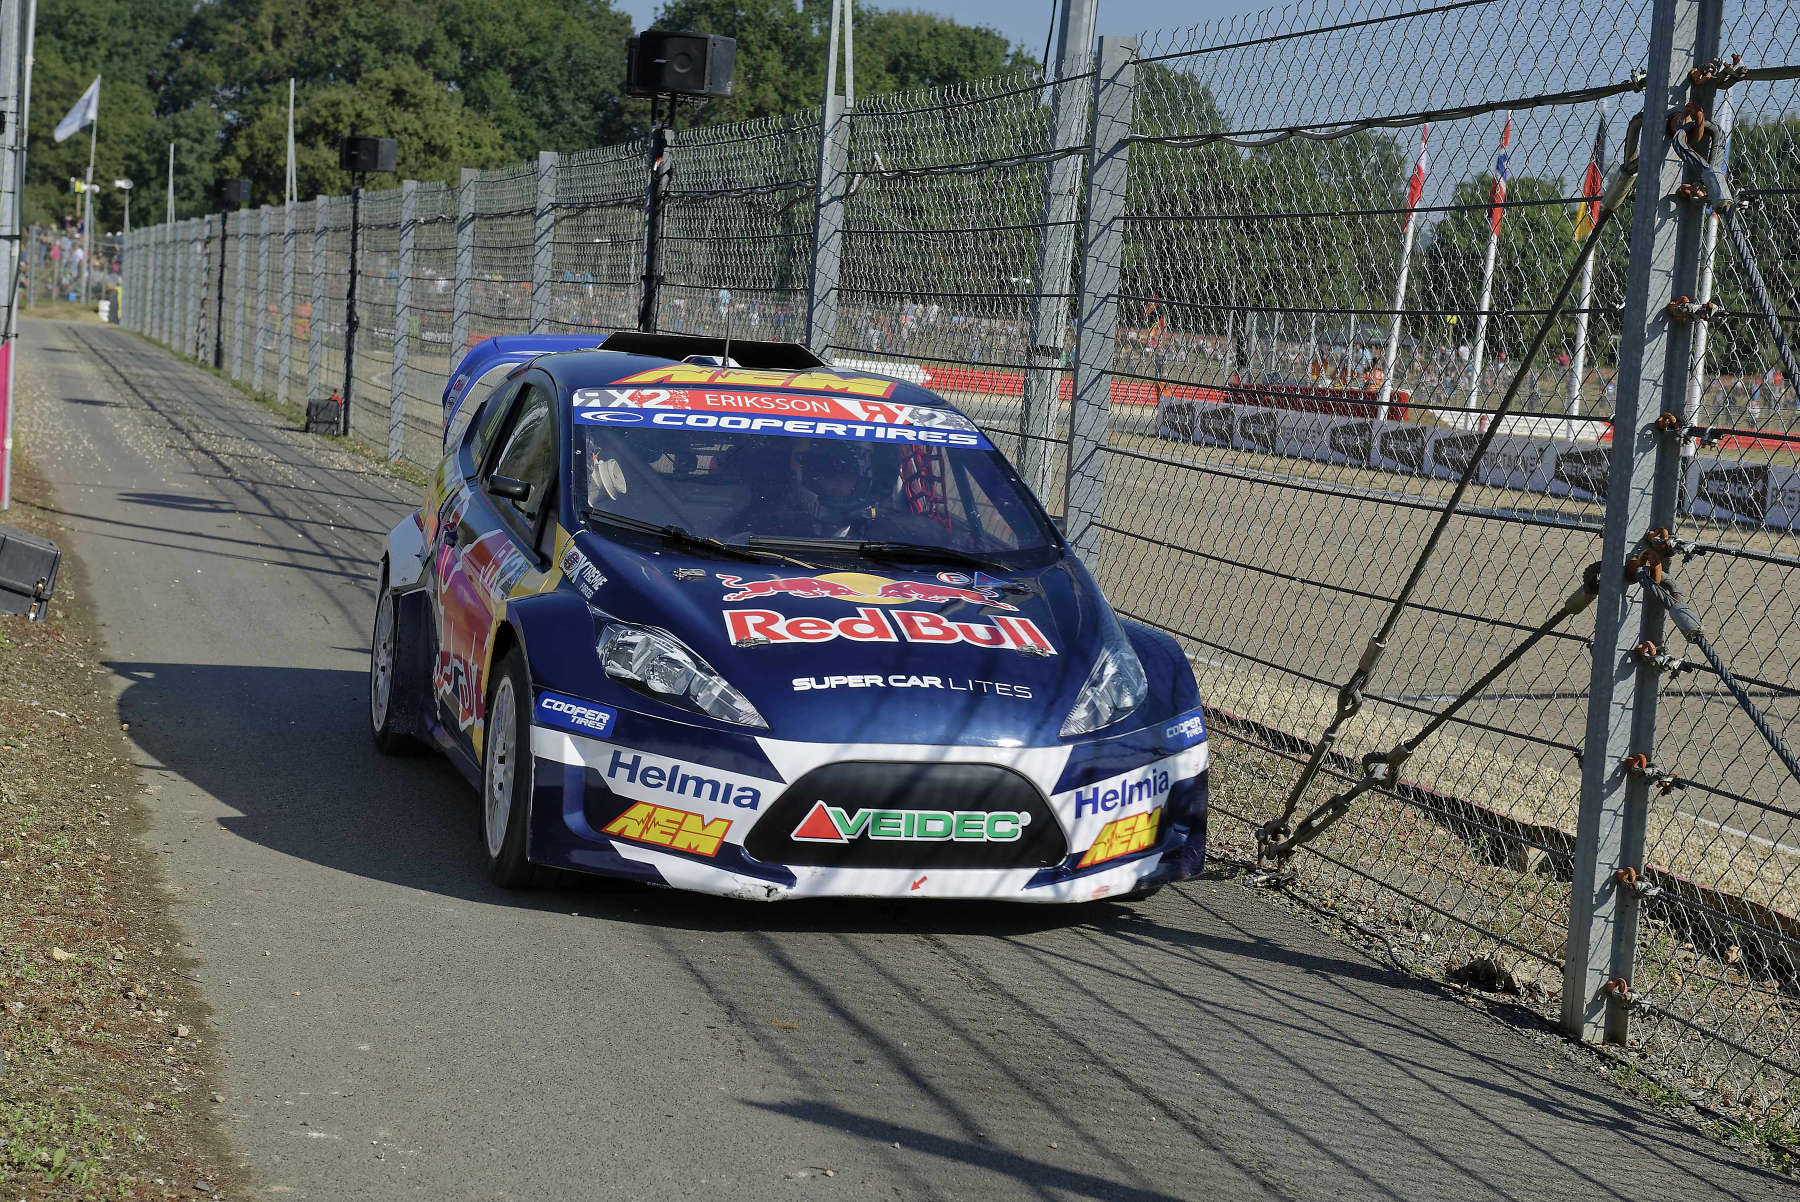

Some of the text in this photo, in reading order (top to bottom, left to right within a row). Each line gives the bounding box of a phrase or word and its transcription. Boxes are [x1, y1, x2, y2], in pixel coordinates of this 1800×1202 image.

[704, 393, 831, 414] ERIKSSON
[570, 555, 608, 591] XTREME
[723, 607, 1058, 655] Red Bull
[792, 674, 1033, 699] SUPER CAR LITES
[540, 698, 610, 723] COOPER
[569, 715, 606, 731] TIRES
[1166, 716, 1202, 739] COOPER
[607, 749, 762, 811] Helmia
[1075, 768, 1169, 819] Helmia
[601, 800, 734, 858] AEM
[1076, 805, 1163, 868] AEM
